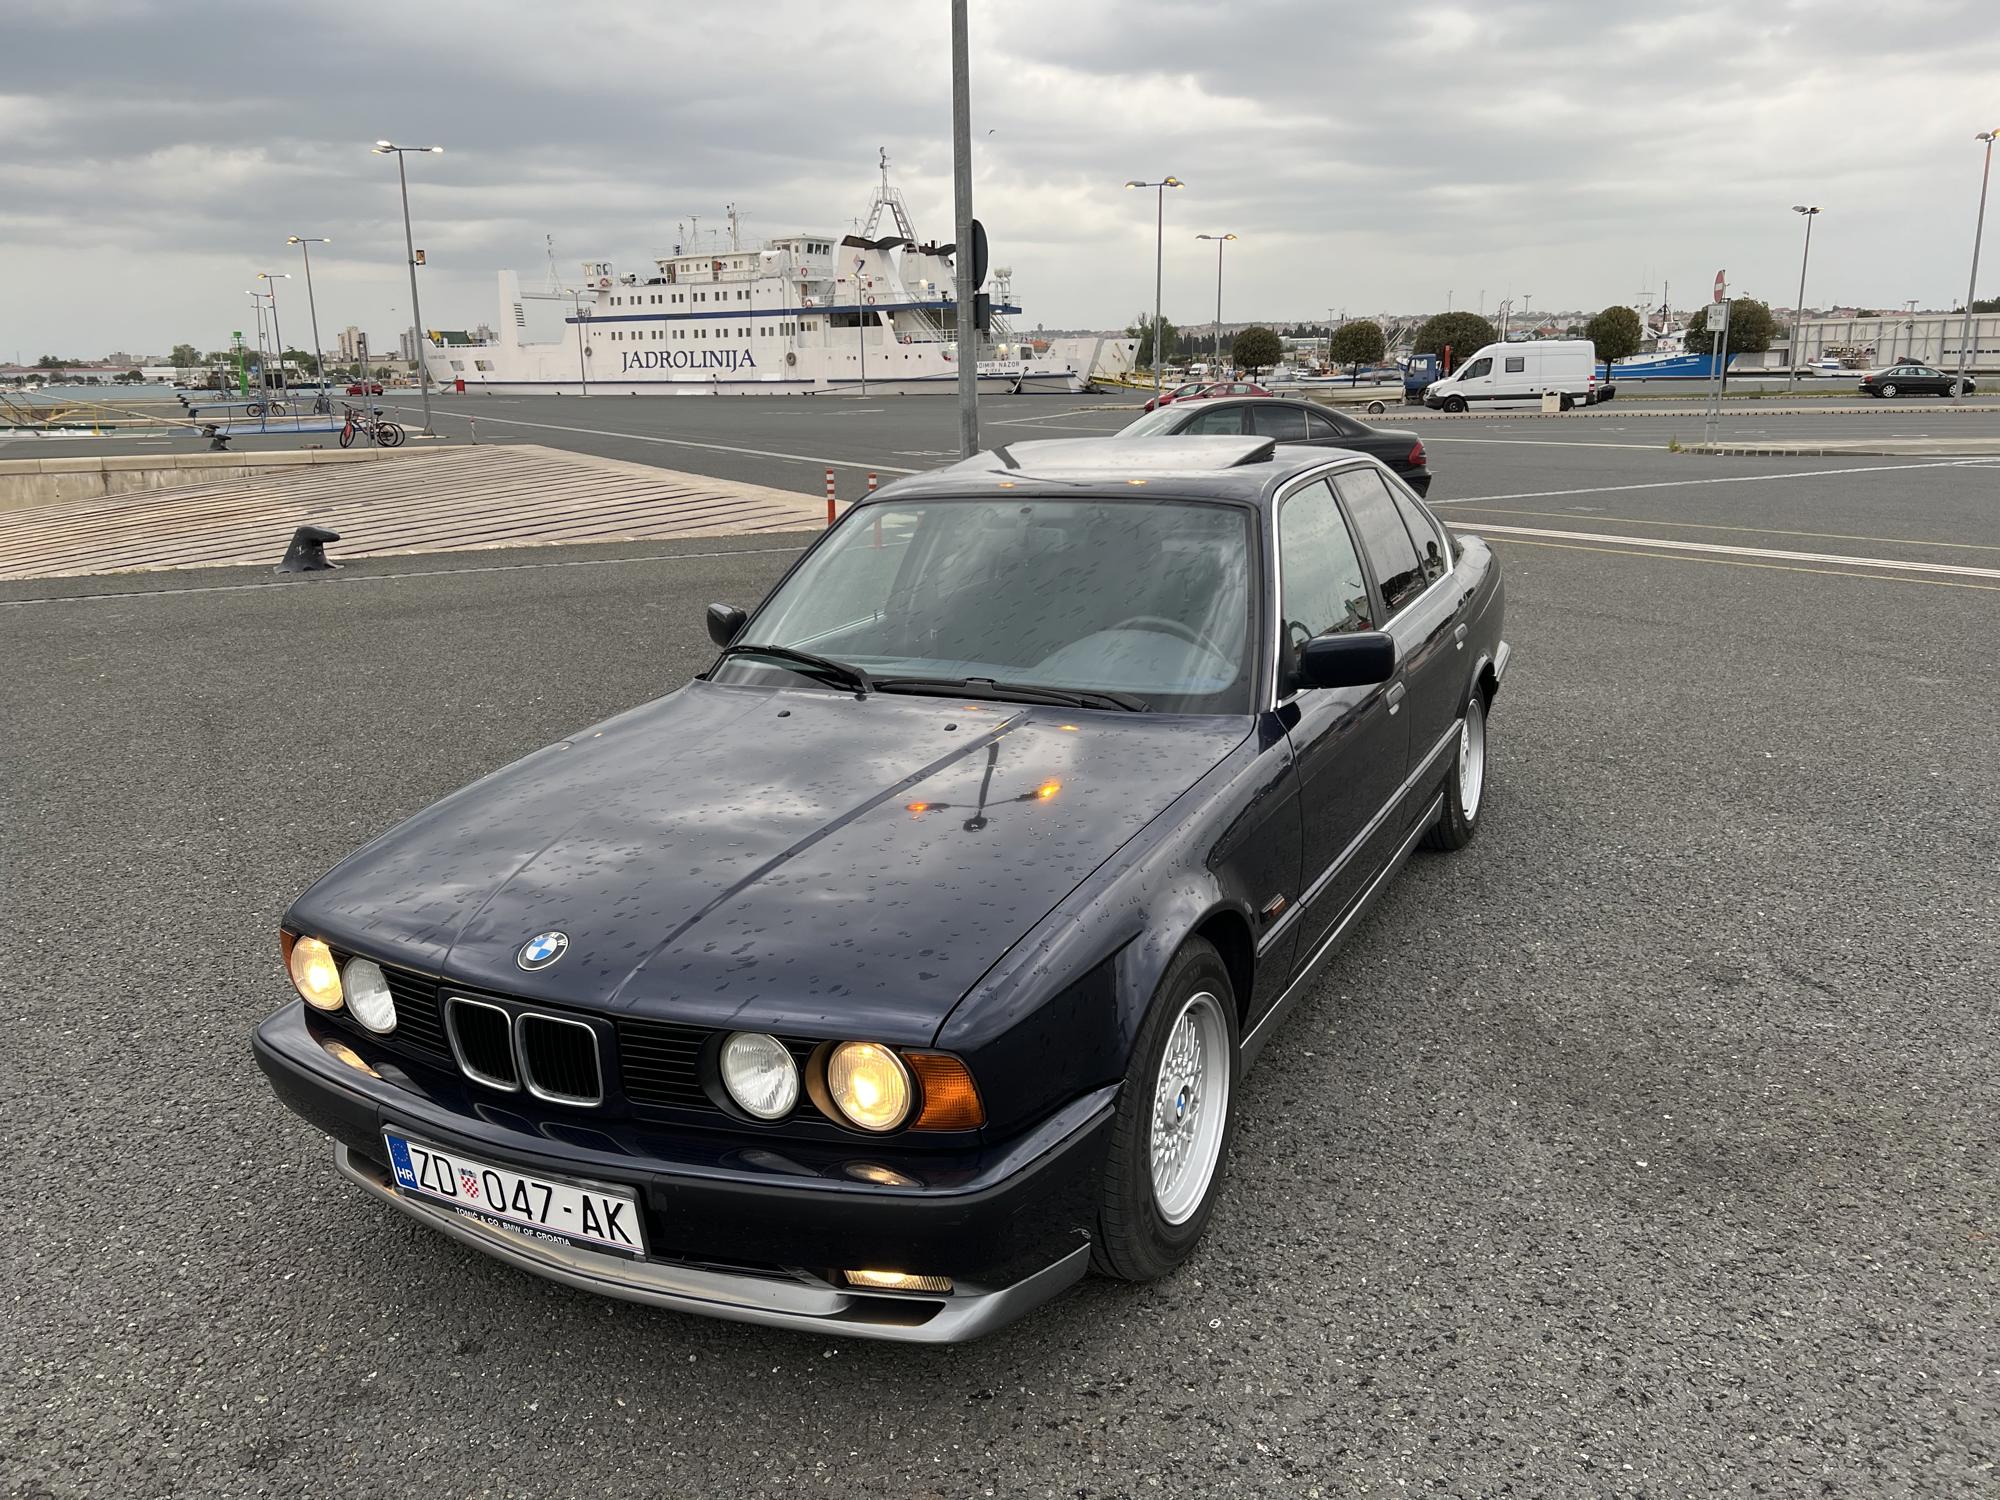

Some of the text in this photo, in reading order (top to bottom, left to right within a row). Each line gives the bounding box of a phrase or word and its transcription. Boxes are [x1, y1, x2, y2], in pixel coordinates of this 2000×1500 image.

[621, 348, 757, 373] JADROLINIJA
[976, 361, 995, 369] DIMIR
[397, 1166, 415, 1182] HR
[411, 1147, 458, 1197] ZD
[480, 1215, 486, 1223] &
[503, 1222, 521, 1233] BMW
[523, 1228, 534, 1236] OF
[536, 1231, 571, 1246] CROATIA
